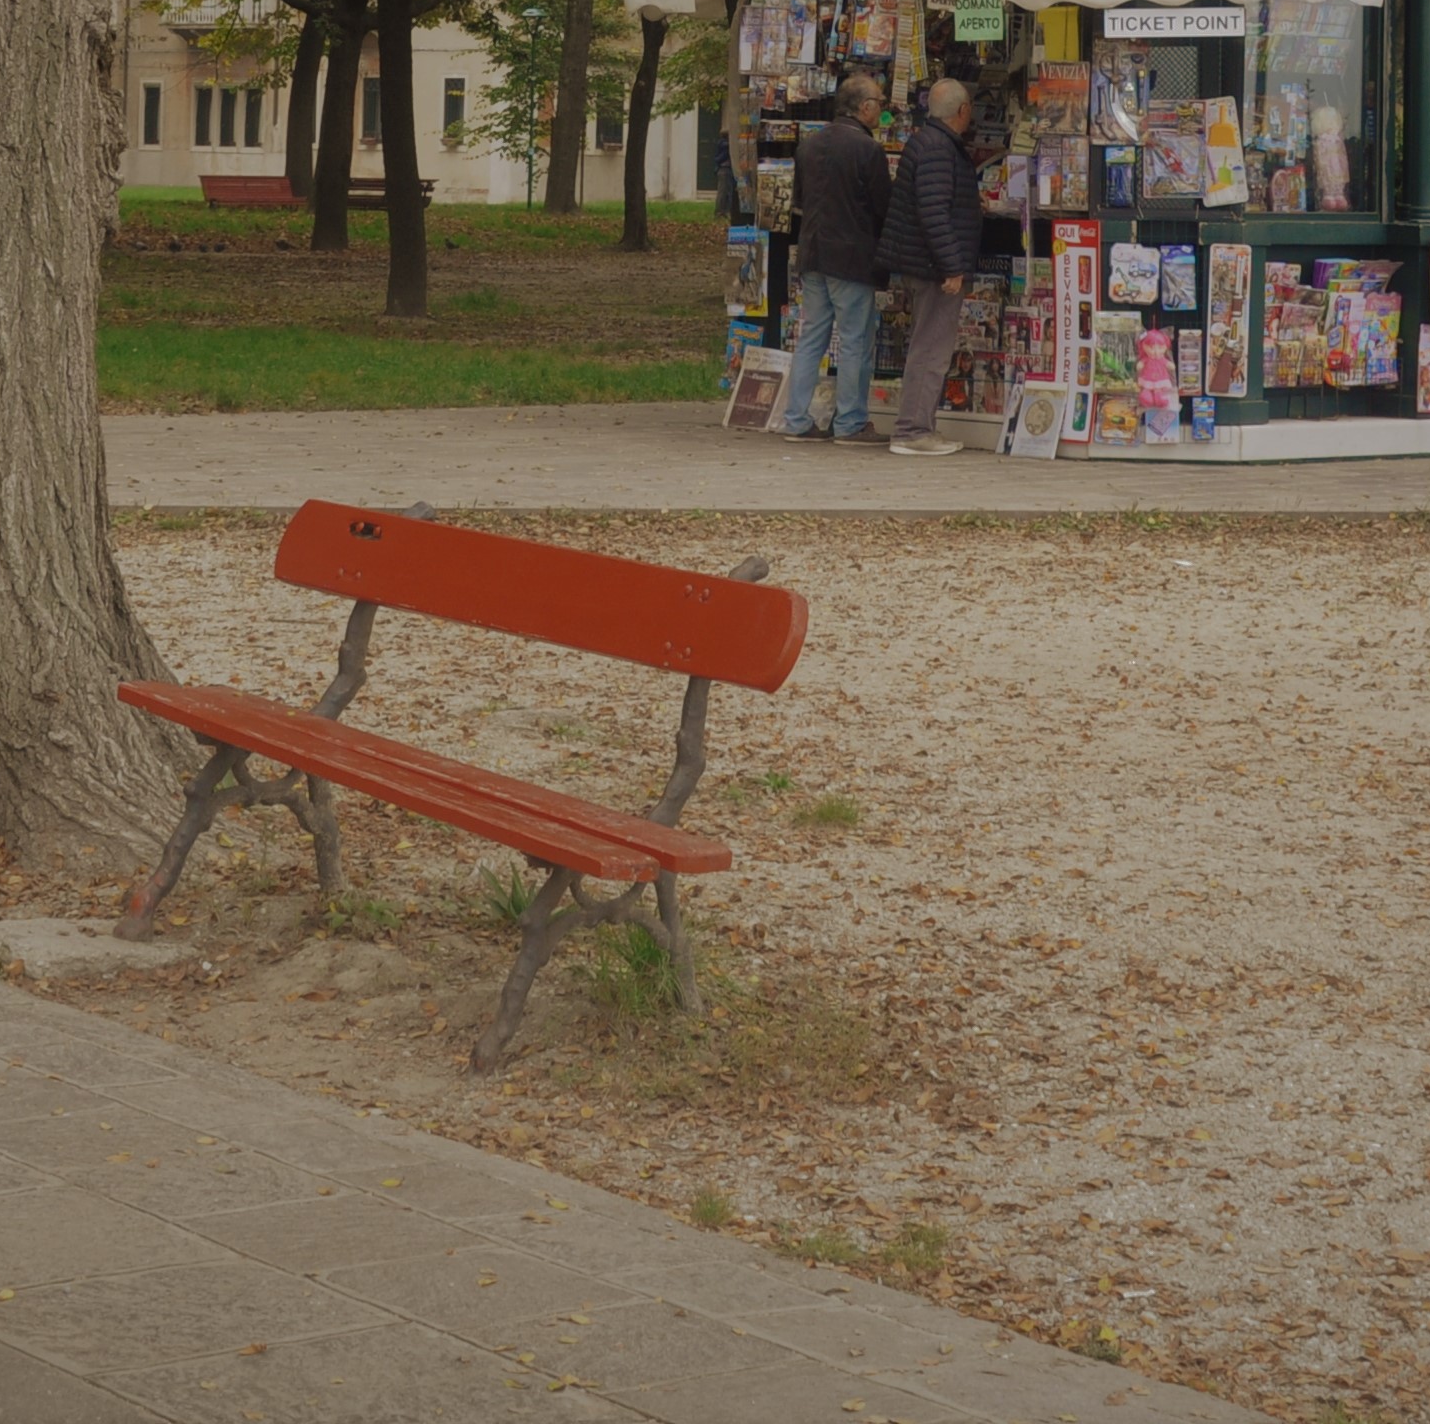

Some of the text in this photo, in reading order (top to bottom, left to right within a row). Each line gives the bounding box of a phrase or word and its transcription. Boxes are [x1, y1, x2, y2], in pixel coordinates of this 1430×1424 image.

[959, 17, 1000, 30] APERTO
[1109, 16, 1240, 30] TICKET POINT
[1040, 62, 1087, 80] VENEZIA
[1058, 227, 1076, 238] QUI
[1063, 254, 1072, 340] BEVANDE
